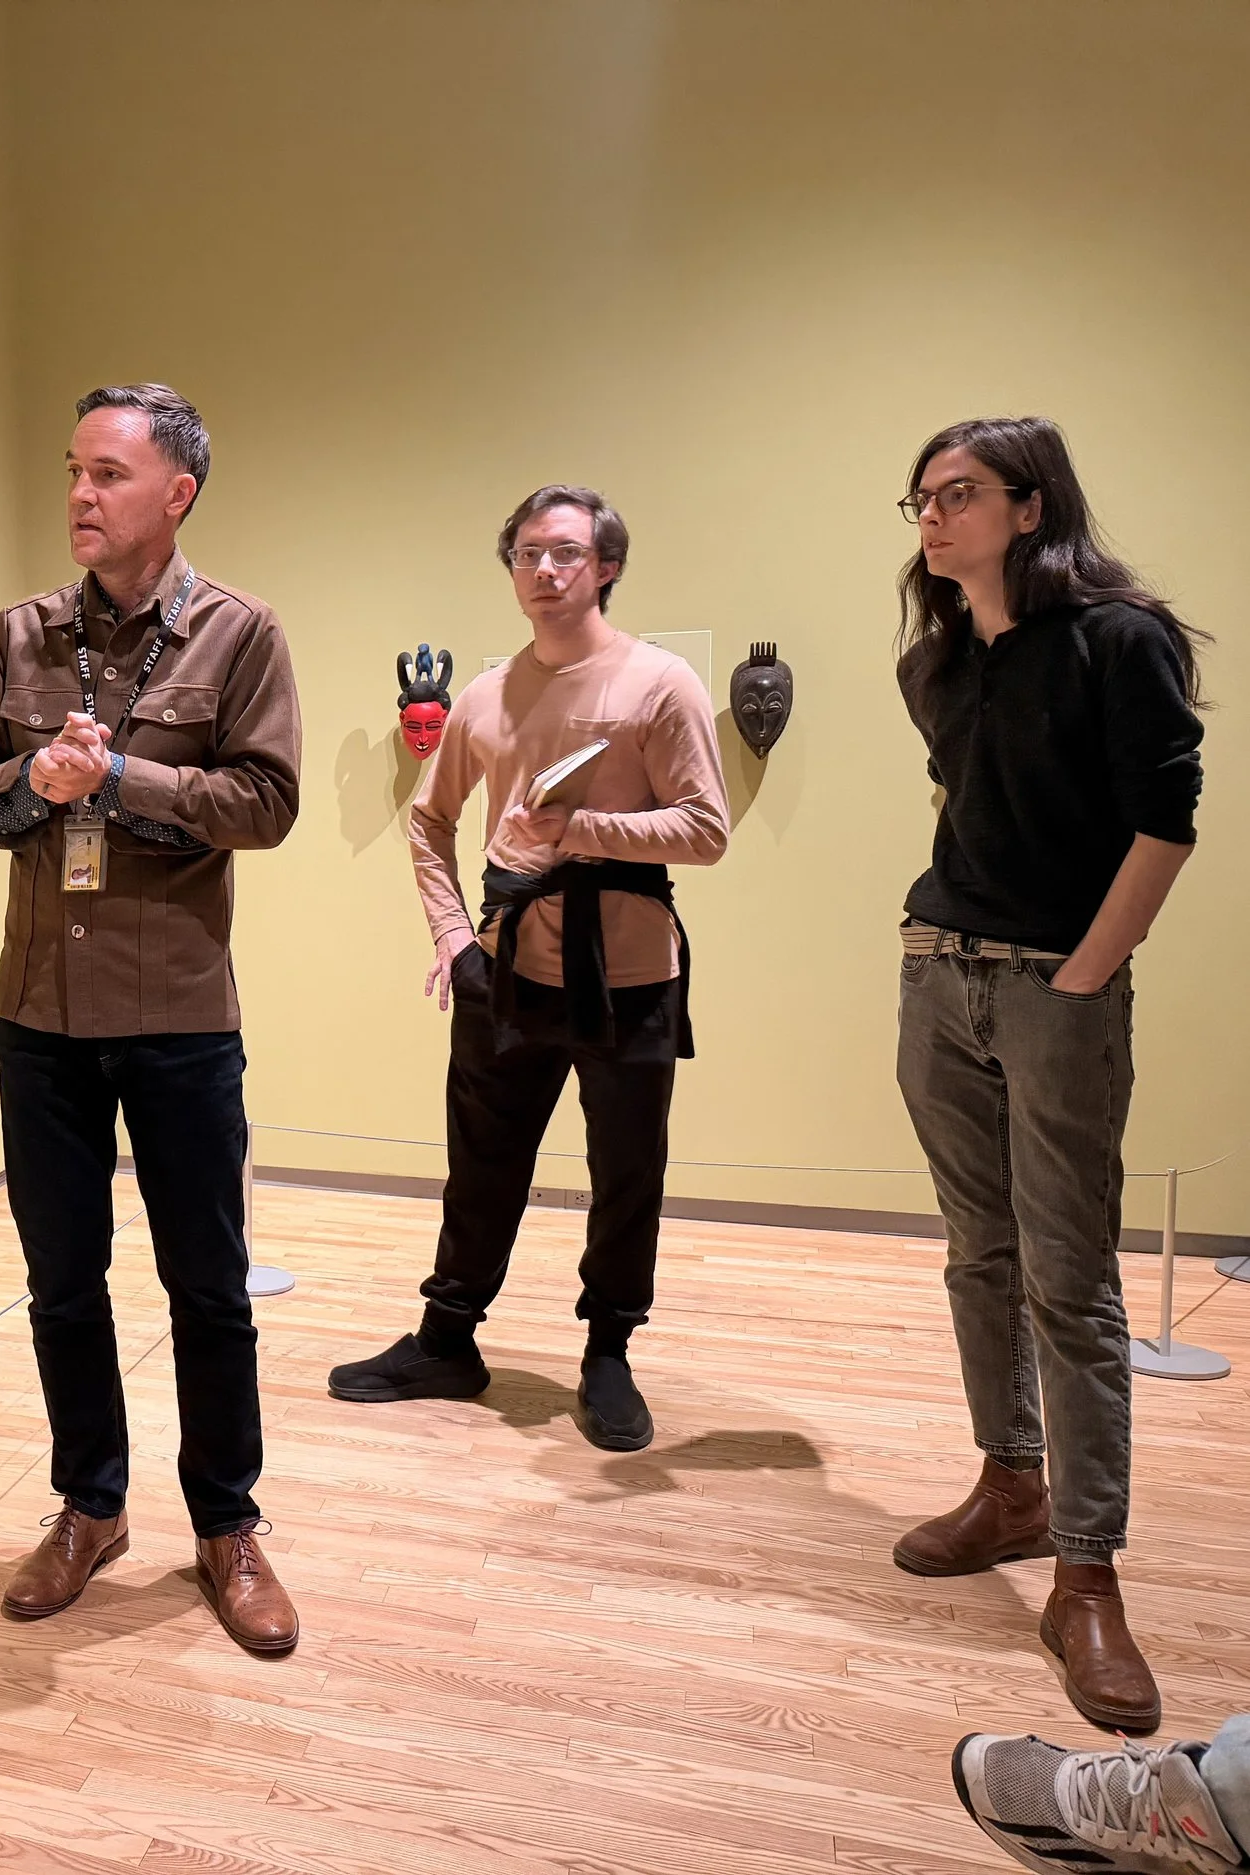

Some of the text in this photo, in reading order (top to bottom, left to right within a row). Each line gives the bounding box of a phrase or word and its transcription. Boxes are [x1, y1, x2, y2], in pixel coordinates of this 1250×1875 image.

[184, 564, 196, 589] STA
[75, 604, 84, 634] STAFF
[164, 596, 184, 628] STAFF
[77, 647, 90, 680] STAFF
[143, 637, 164, 673] STAFF
[85, 693, 96, 720] STAF
[122, 684, 140, 719] STAFF
